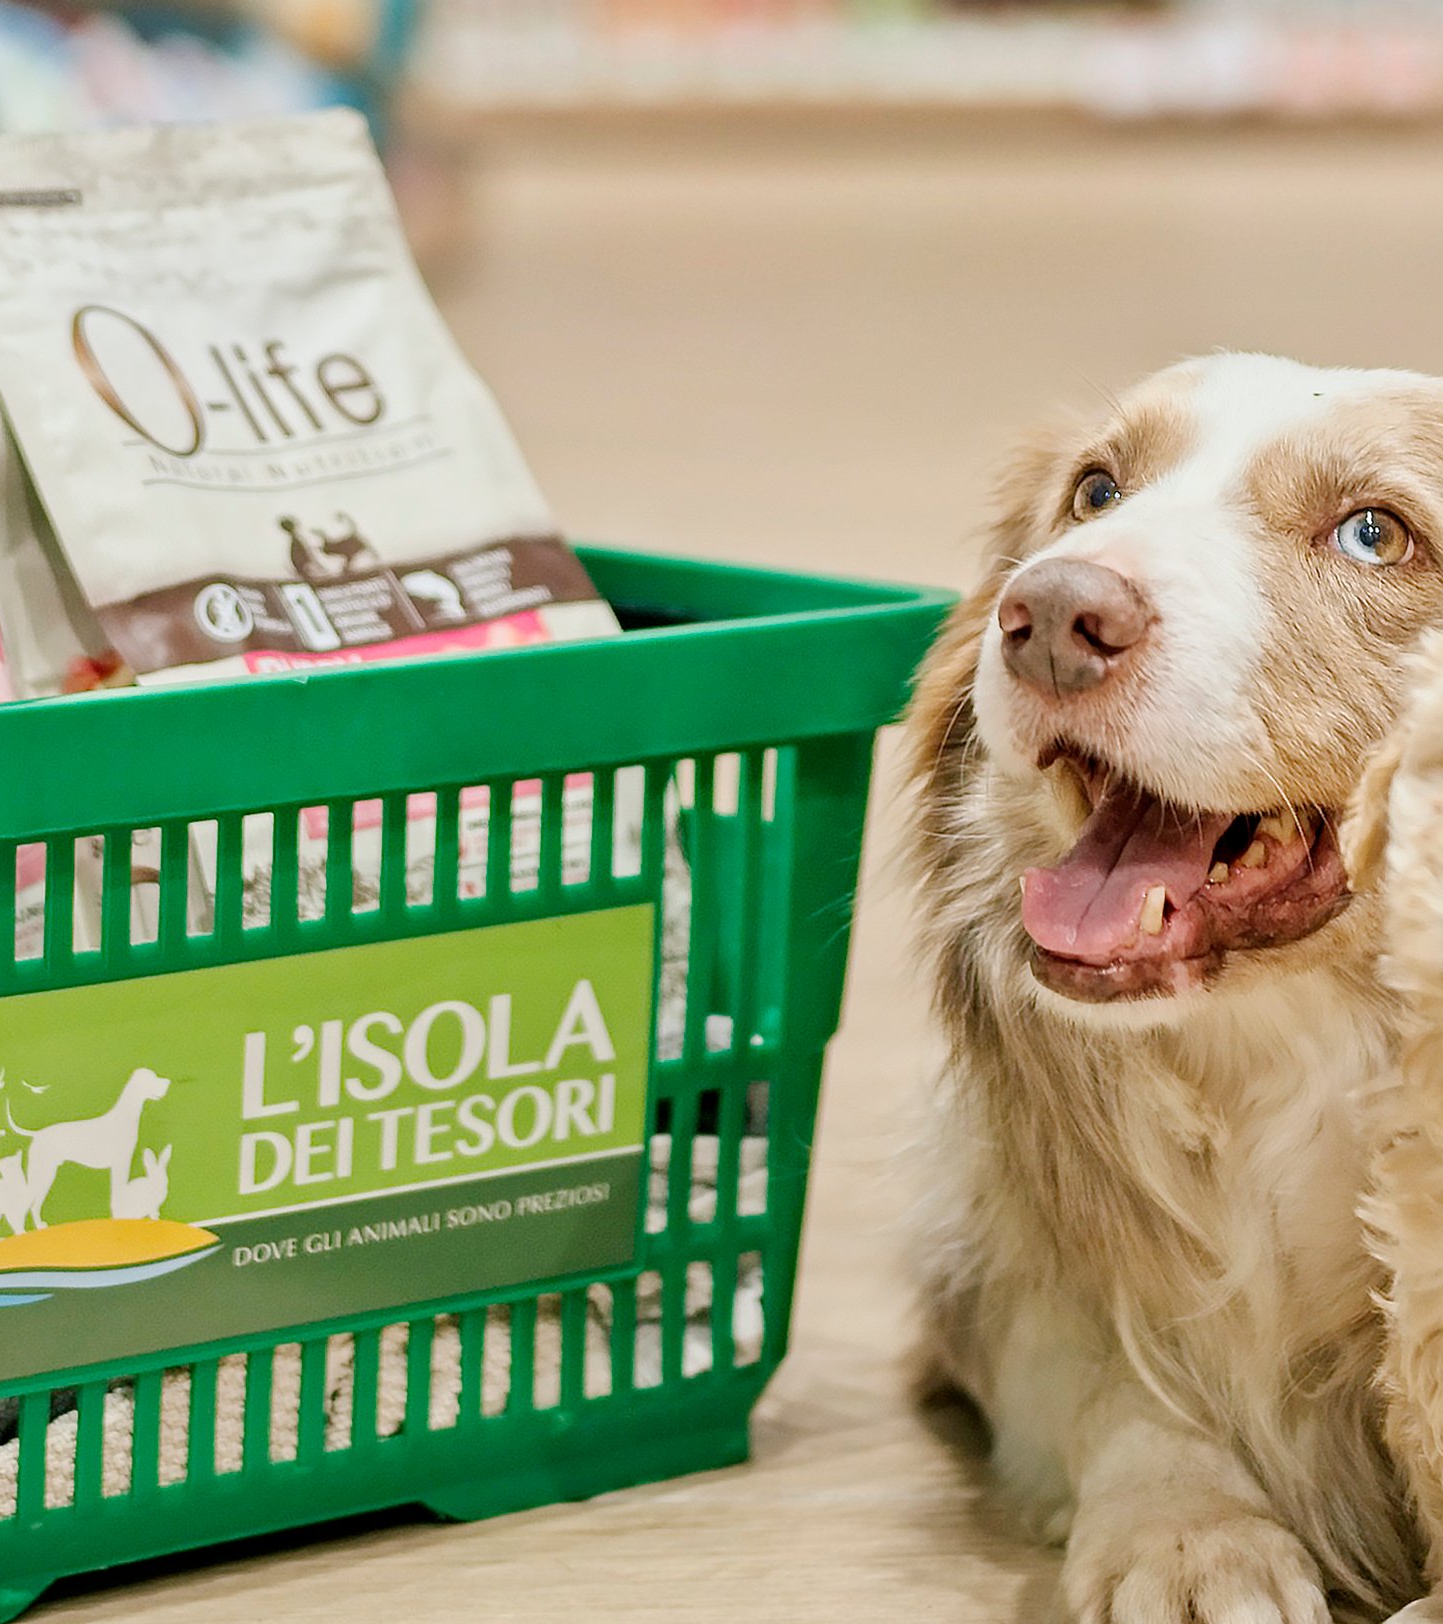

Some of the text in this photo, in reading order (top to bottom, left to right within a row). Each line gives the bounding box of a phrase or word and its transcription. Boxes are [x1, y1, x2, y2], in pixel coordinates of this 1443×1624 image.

[72, 304, 386, 458] O-life
[242, 979, 616, 1120] L'ISOLA
[238, 1073, 616, 1195] DEI TESORI
[232, 1182, 610, 1267] DOVE GLI ANIMALI SONO PREZIOSI
